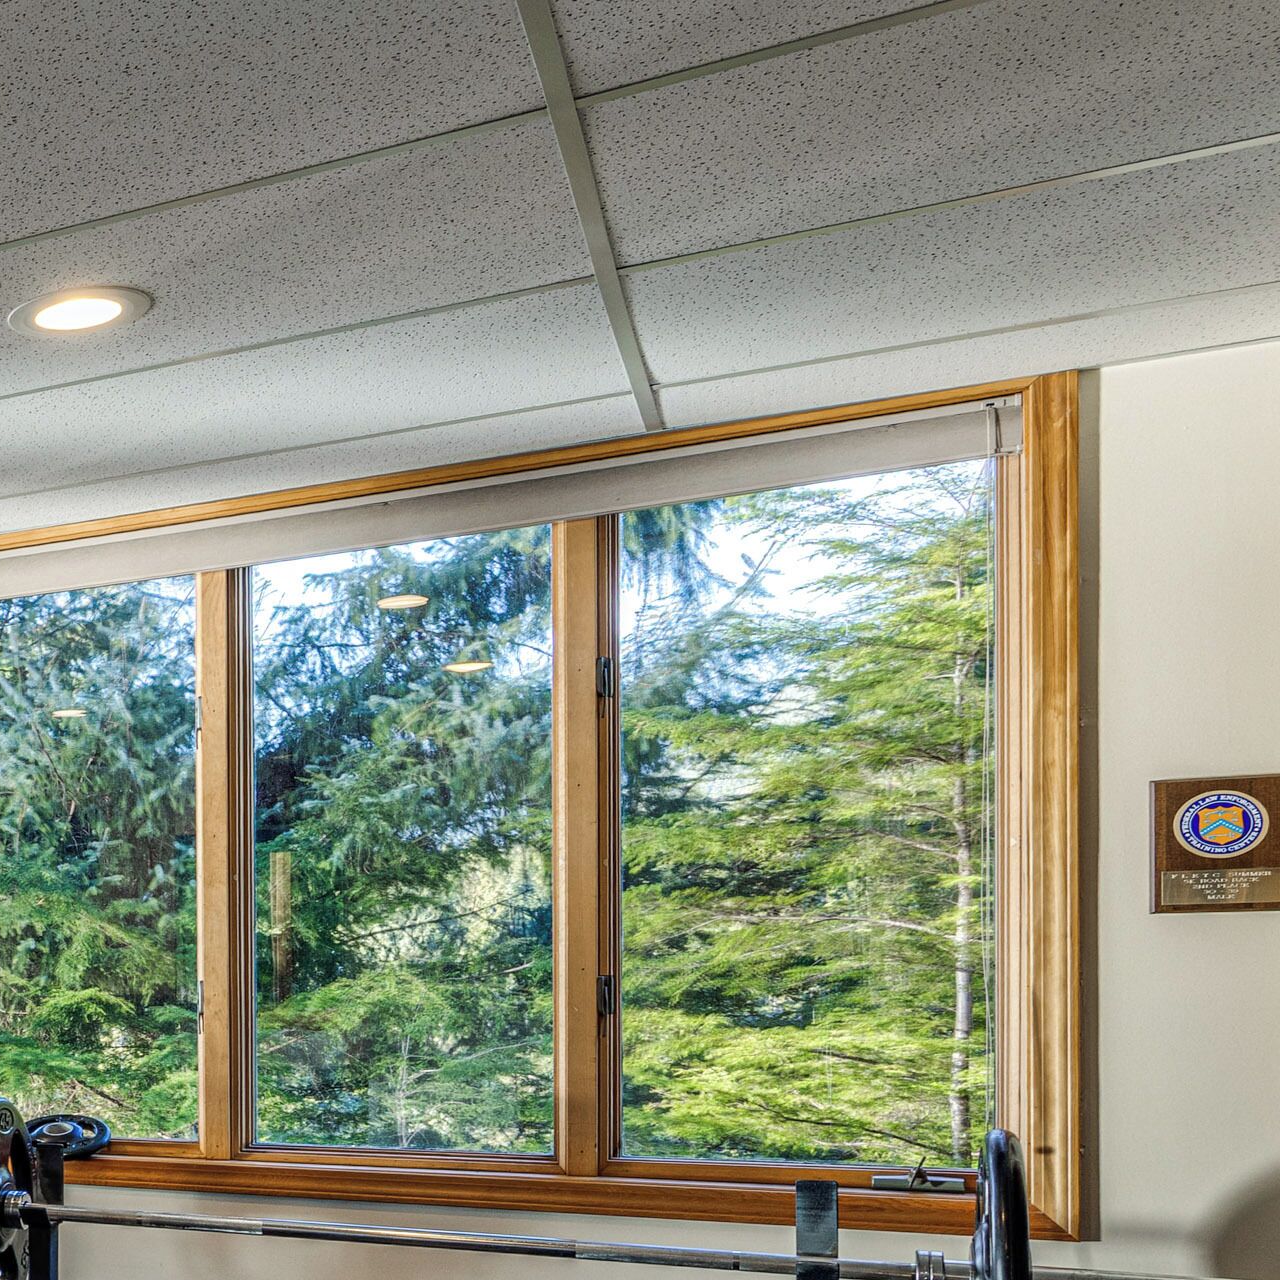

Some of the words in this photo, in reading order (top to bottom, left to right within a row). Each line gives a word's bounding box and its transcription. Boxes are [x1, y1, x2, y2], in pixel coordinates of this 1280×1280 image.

[1182, 804, 1200, 834] FEDERAL
[1199, 795, 1218, 806] LAW
[1220, 795, 1262, 830] ENFORCEMENT
[1188, 837, 1227, 853] TRAINING
[1228, 831, 1258, 852] CENTER
